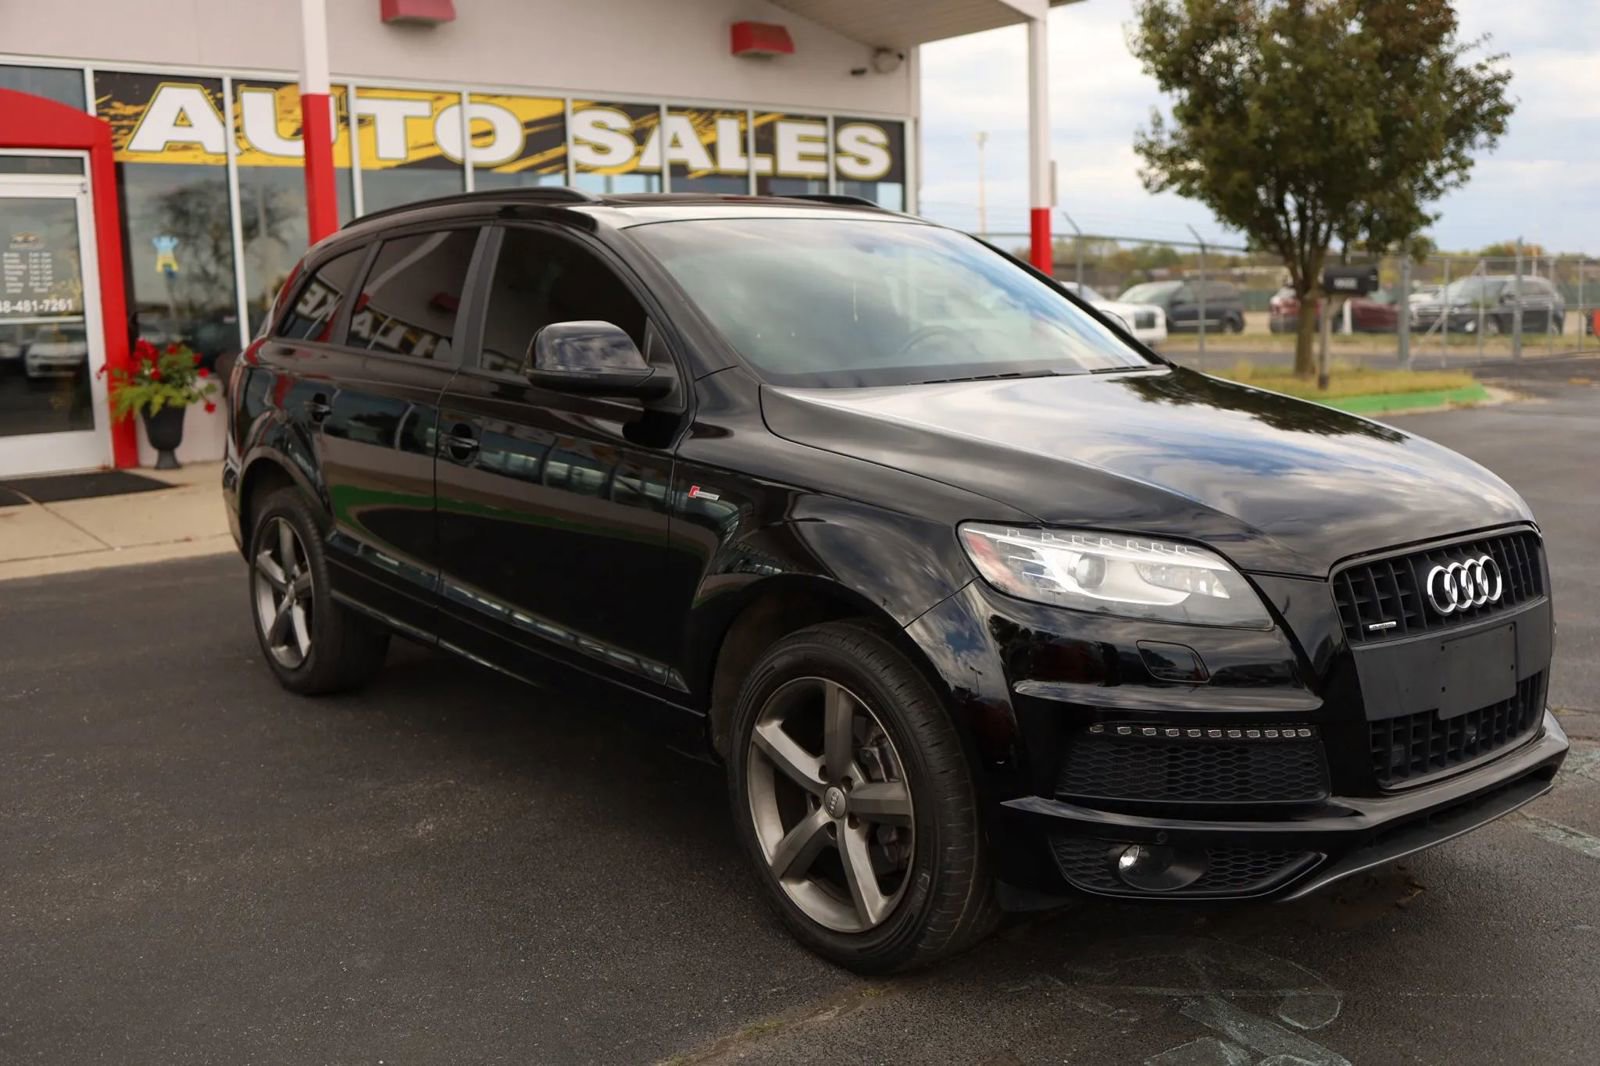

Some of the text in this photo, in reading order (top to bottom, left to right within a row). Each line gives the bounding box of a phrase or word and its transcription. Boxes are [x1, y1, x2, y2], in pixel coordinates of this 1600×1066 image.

[127, 83, 892, 180] AUTO SALES
[0, 299, 73, 313] 8-481-7261
